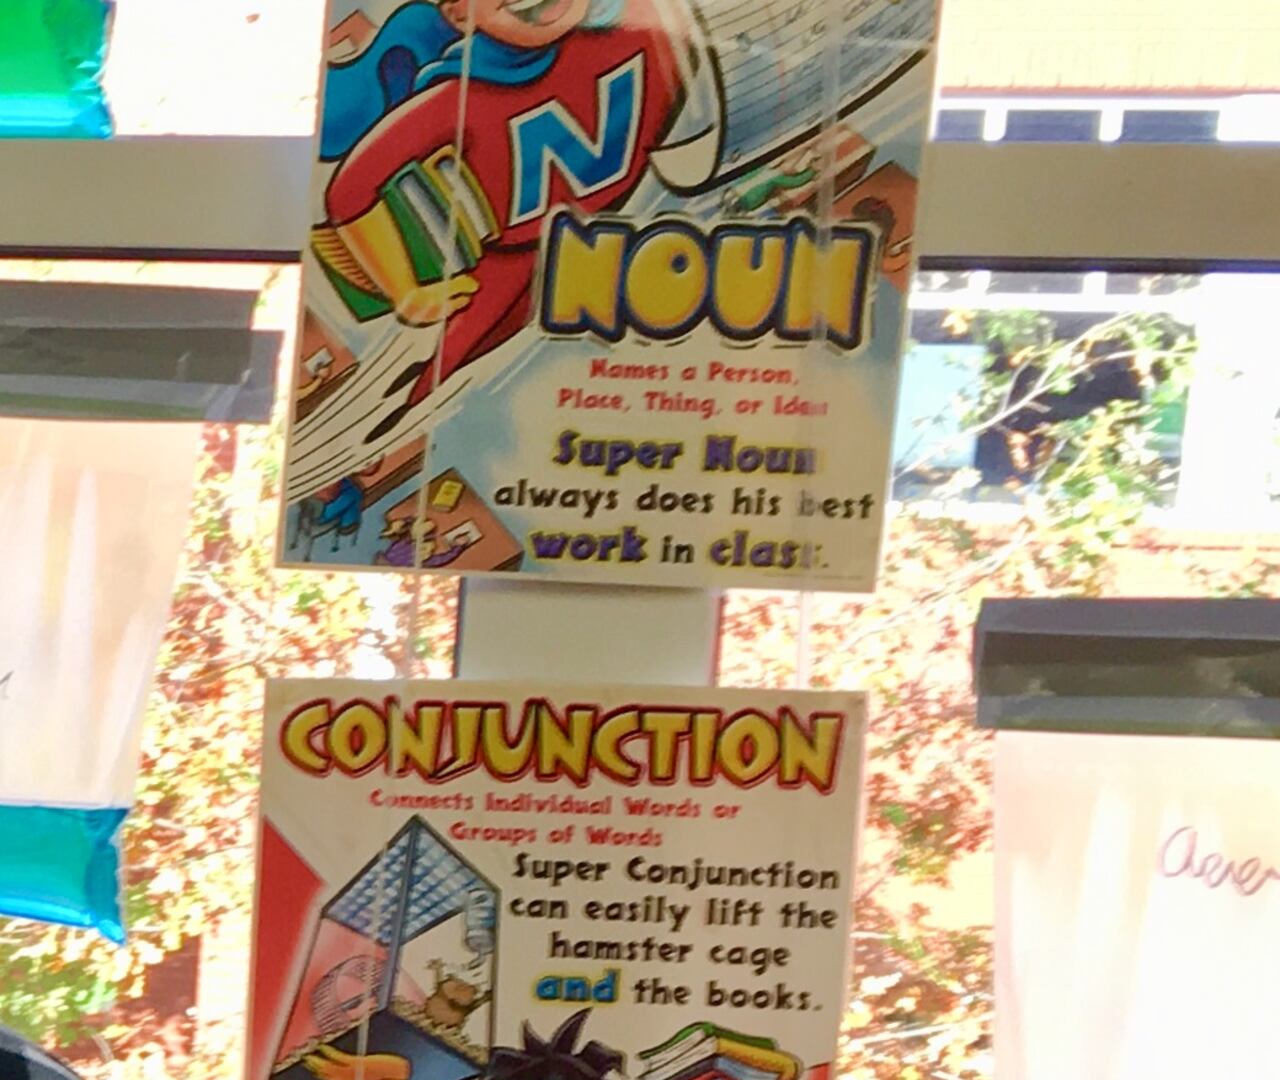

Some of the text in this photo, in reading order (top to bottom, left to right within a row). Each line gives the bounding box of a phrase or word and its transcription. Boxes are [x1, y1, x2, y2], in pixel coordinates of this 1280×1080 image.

[542, 211, 874, 351] NOUN
[589, 357, 800, 387] Names a Person,
[555, 388, 632, 414] Place,
[644, 391, 722, 420] Thing,
[735, 398, 762, 416] or
[552, 429, 818, 477] Super Noun
[493, 479, 875, 520] always does his best
[530, 526, 648, 564] work
[660, 535, 695, 565] in
[280, 695, 847, 796] CONJUNCTION
[485, 792, 613, 816] Individual
[623, 798, 702, 820] Words
[712, 803, 741, 820] or
[448, 820, 664, 847] Groups of Words
[511, 852, 841, 891] Super Conjunction
[509, 896, 839, 932] can easily lift the
[549, 931, 792, 976] hamster cage
[536, 969, 824, 1013] and the books.
